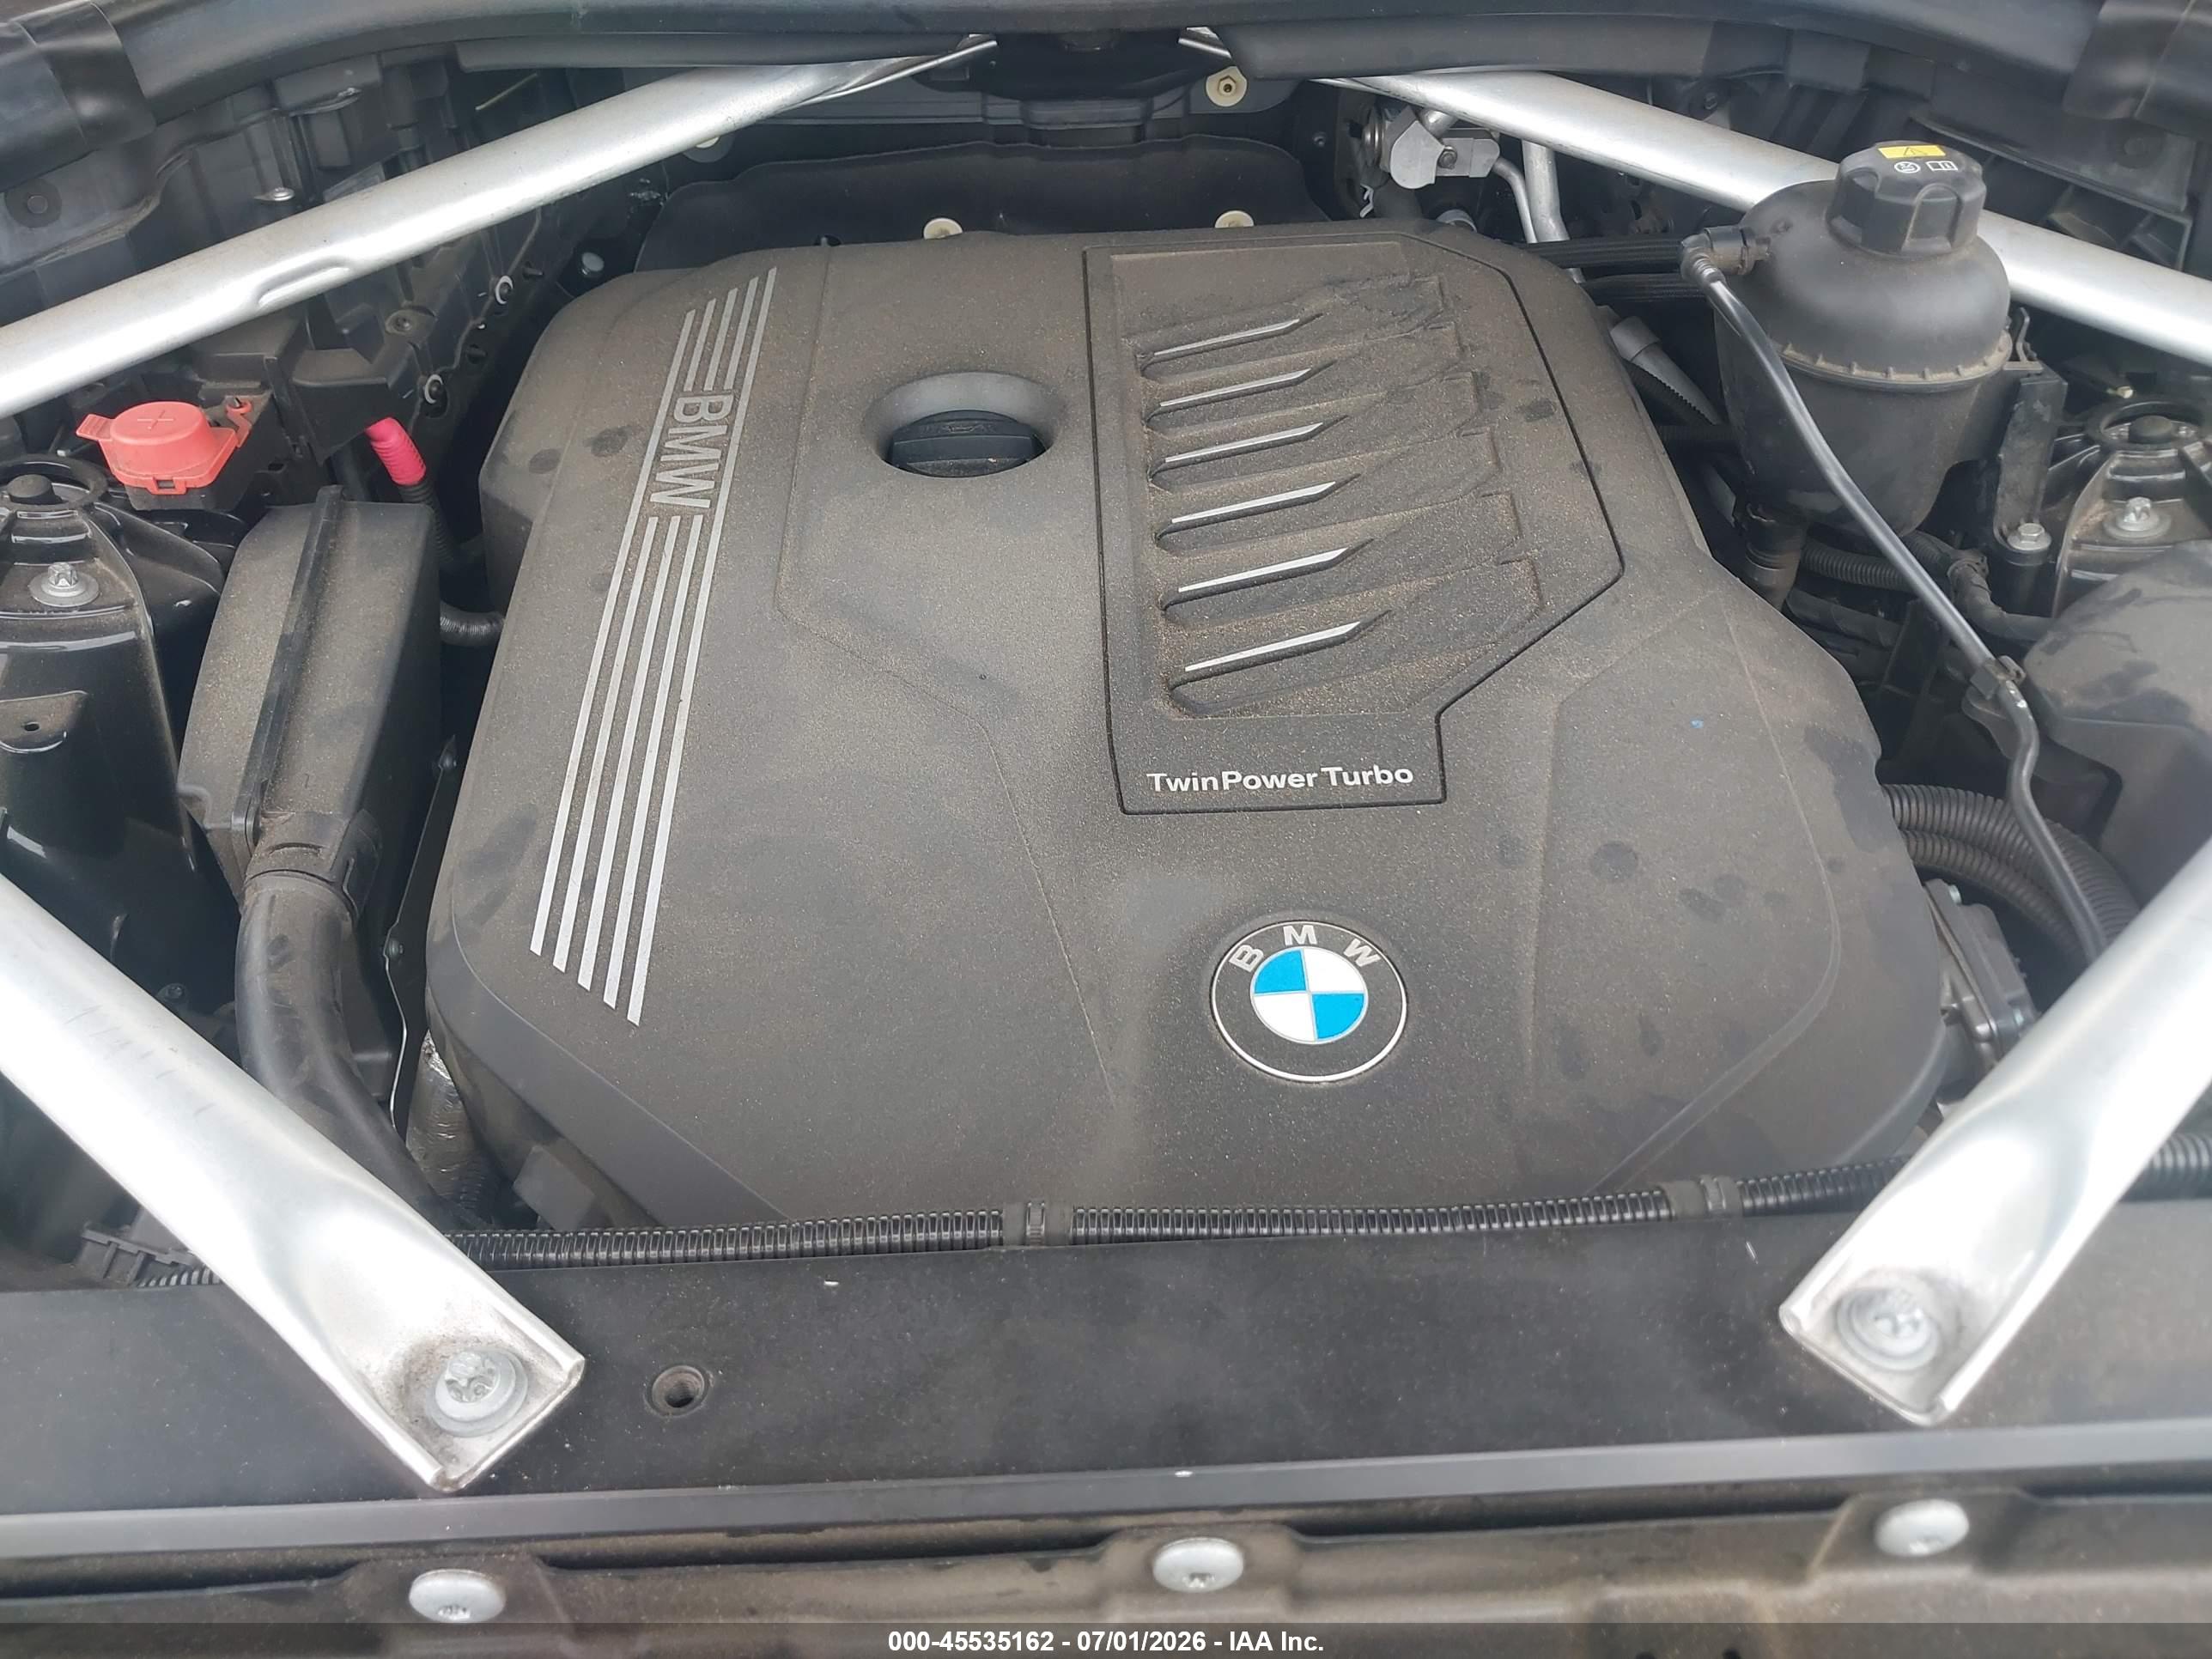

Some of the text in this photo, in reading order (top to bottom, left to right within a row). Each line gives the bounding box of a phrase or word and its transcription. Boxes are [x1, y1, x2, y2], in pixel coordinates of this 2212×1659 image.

[650, 395, 734, 508] BMW
[1146, 764, 1414, 792] TwinPower Turbo
[1229, 925, 1381, 972] BMW
